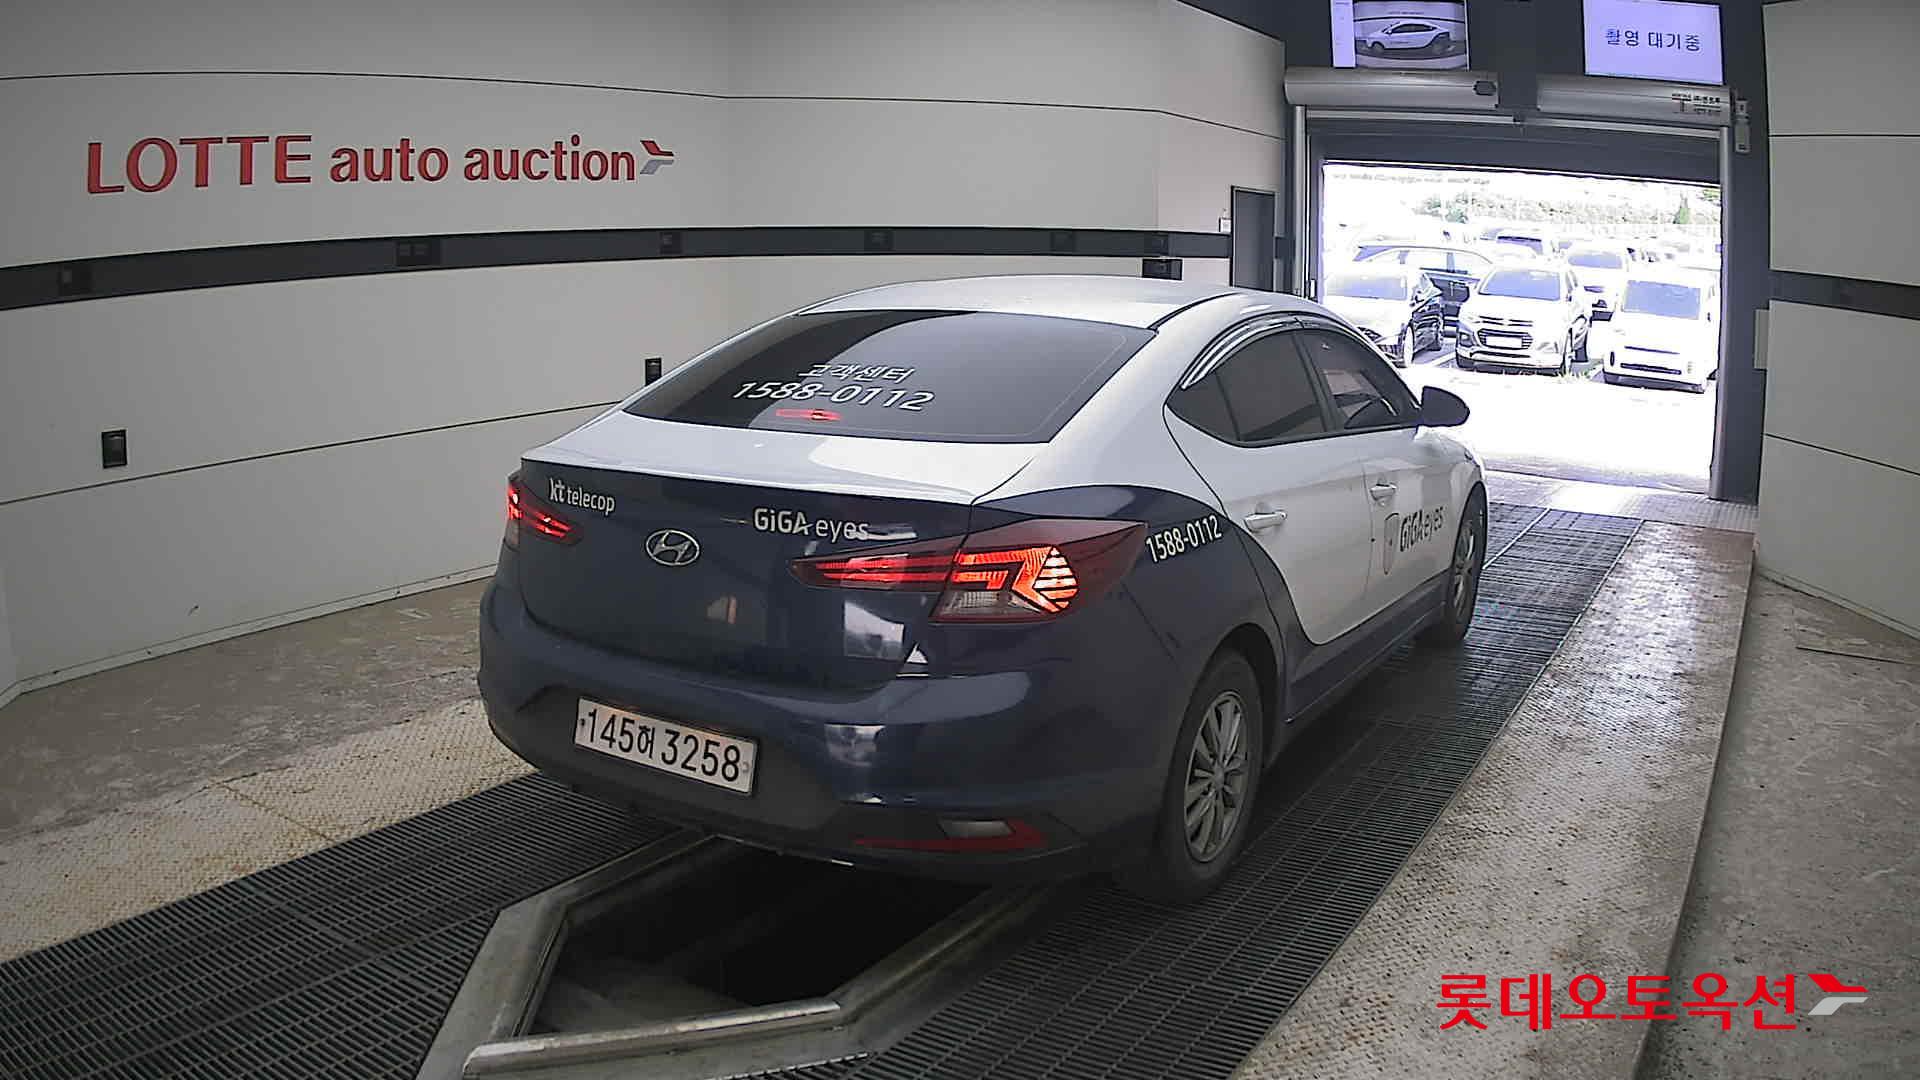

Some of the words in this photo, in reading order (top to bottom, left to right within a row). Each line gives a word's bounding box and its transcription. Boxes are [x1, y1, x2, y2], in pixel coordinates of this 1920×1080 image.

[87, 135, 312, 194] LOTTE
[329, 138, 448, 184] auto
[463, 134, 635, 182] auction
[798, 364, 915, 383] 고객센터
[733, 382, 935, 411] 1588-0112
[549, 478, 565, 502] kt
[567, 487, 615, 515] telecop
[815, 517, 869, 542] eyes
[1145, 514, 1223, 564] 1588-0112
[588, 708, 656, 760] 145허
[660, 728, 741, 782] 3258
